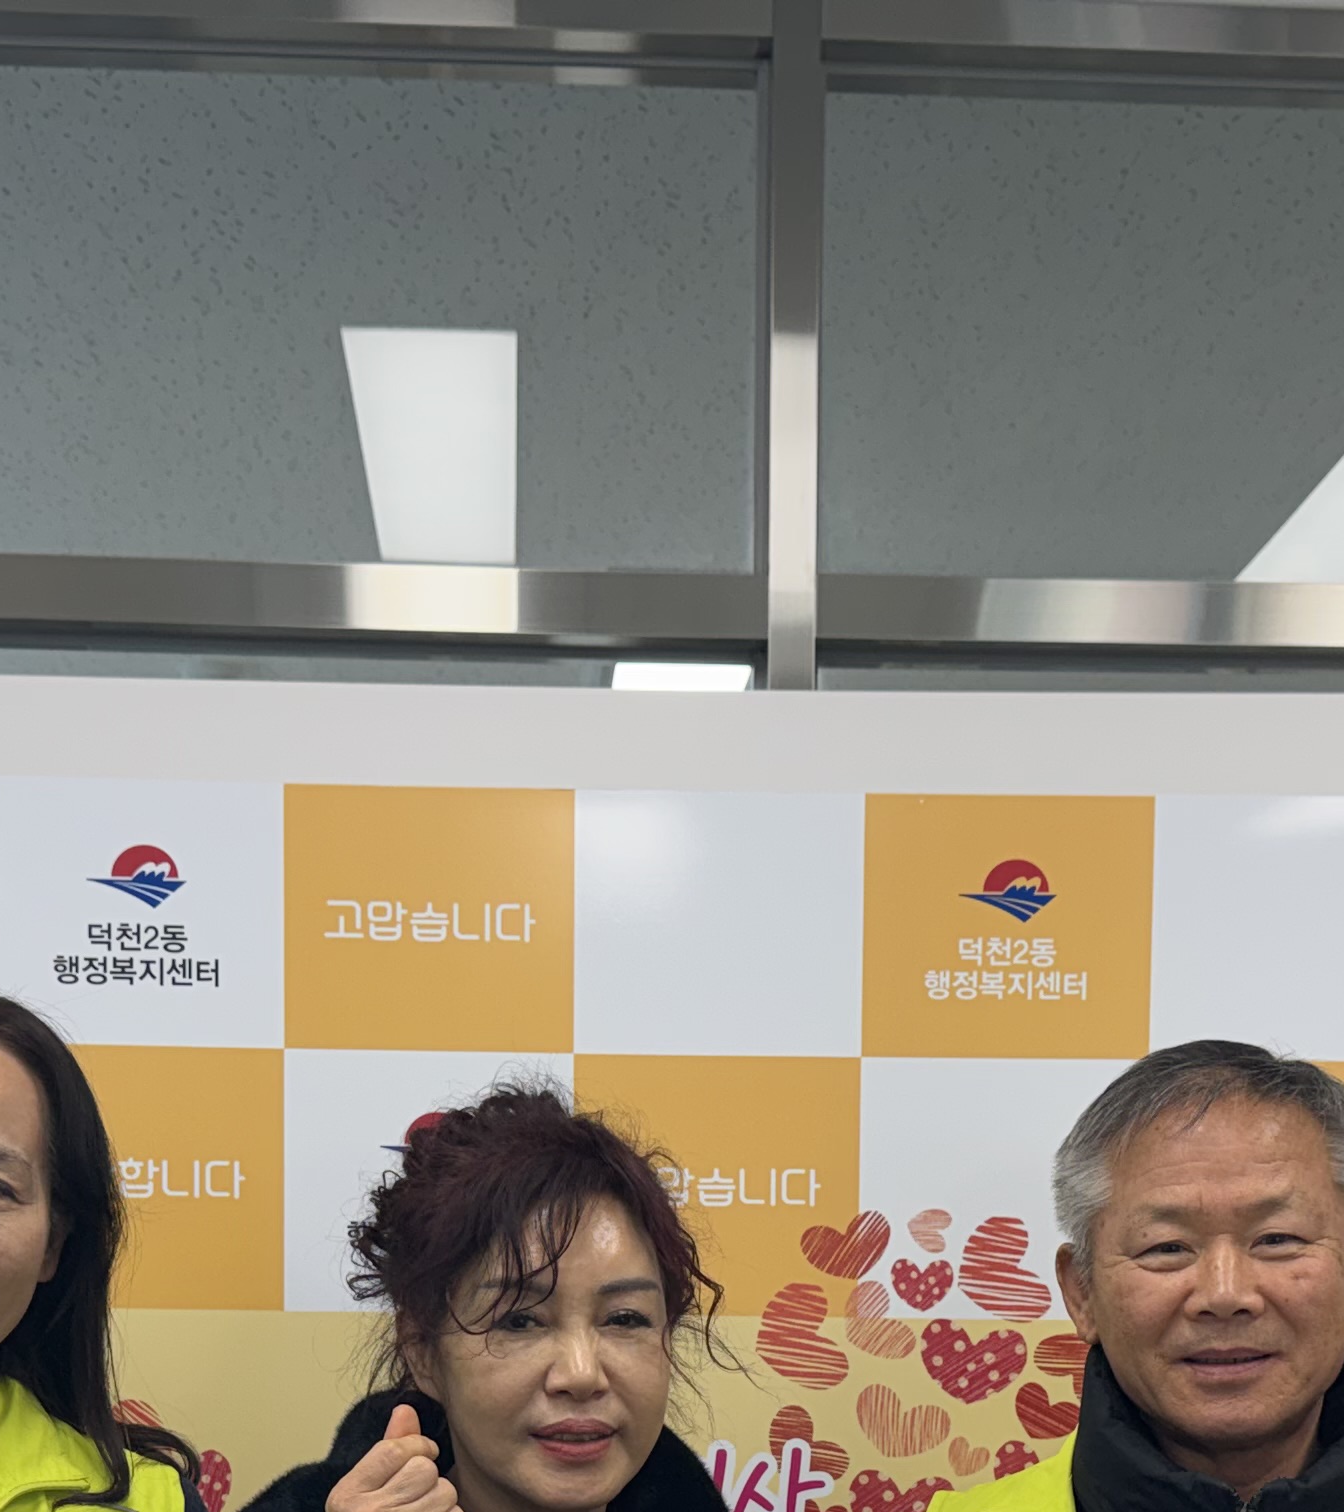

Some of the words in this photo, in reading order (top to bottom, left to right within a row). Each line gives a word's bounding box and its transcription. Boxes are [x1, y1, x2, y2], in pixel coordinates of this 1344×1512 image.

[324, 900, 536, 943] 고맙습니다
[87, 923, 188, 953] 덕천2동
[958, 937, 1056, 967] 덕천2동
[53, 955, 220, 988] 행정복지센터
[924, 969, 1088, 1001] 행정복지센터
